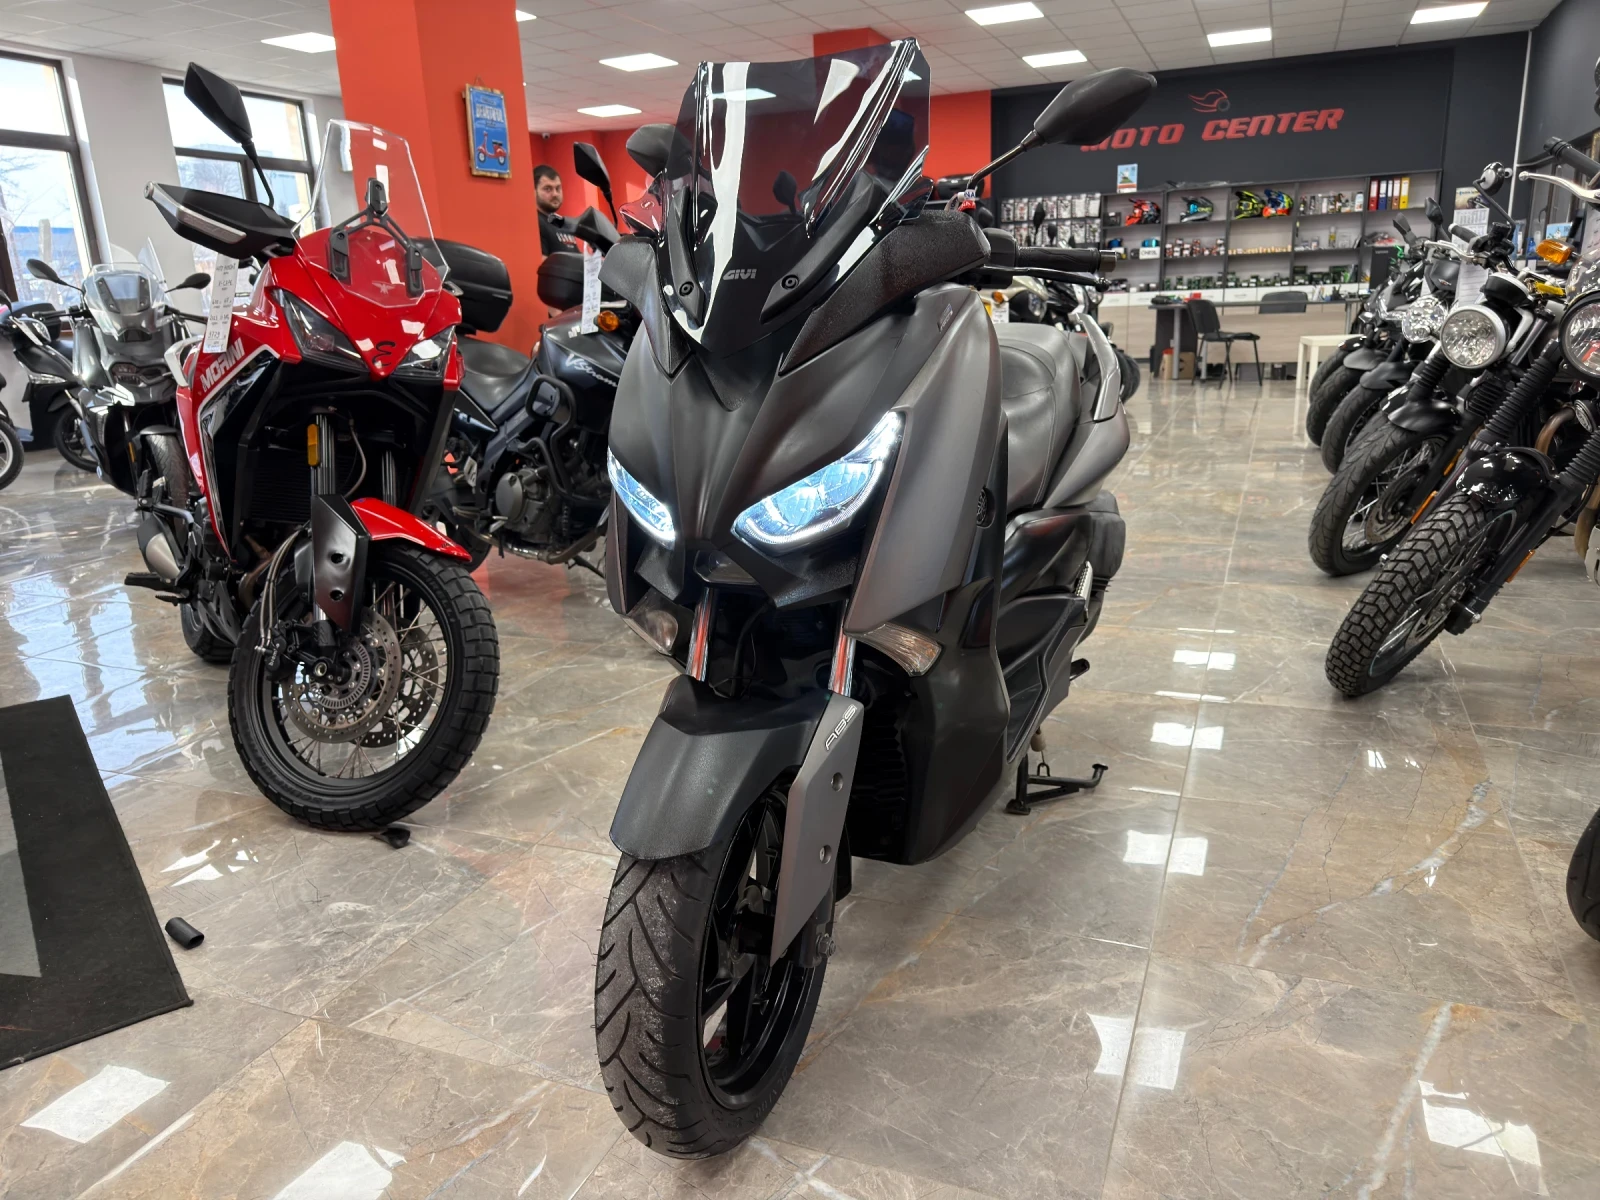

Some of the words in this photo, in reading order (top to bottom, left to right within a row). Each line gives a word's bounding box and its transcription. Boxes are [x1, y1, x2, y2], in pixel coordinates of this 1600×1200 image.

[1201, 108, 1344, 141] CENTER
[722, 268, 757, 280] GIVI
[200, 338, 245, 392] MORINI
[825, 704, 857, 750] ABS
